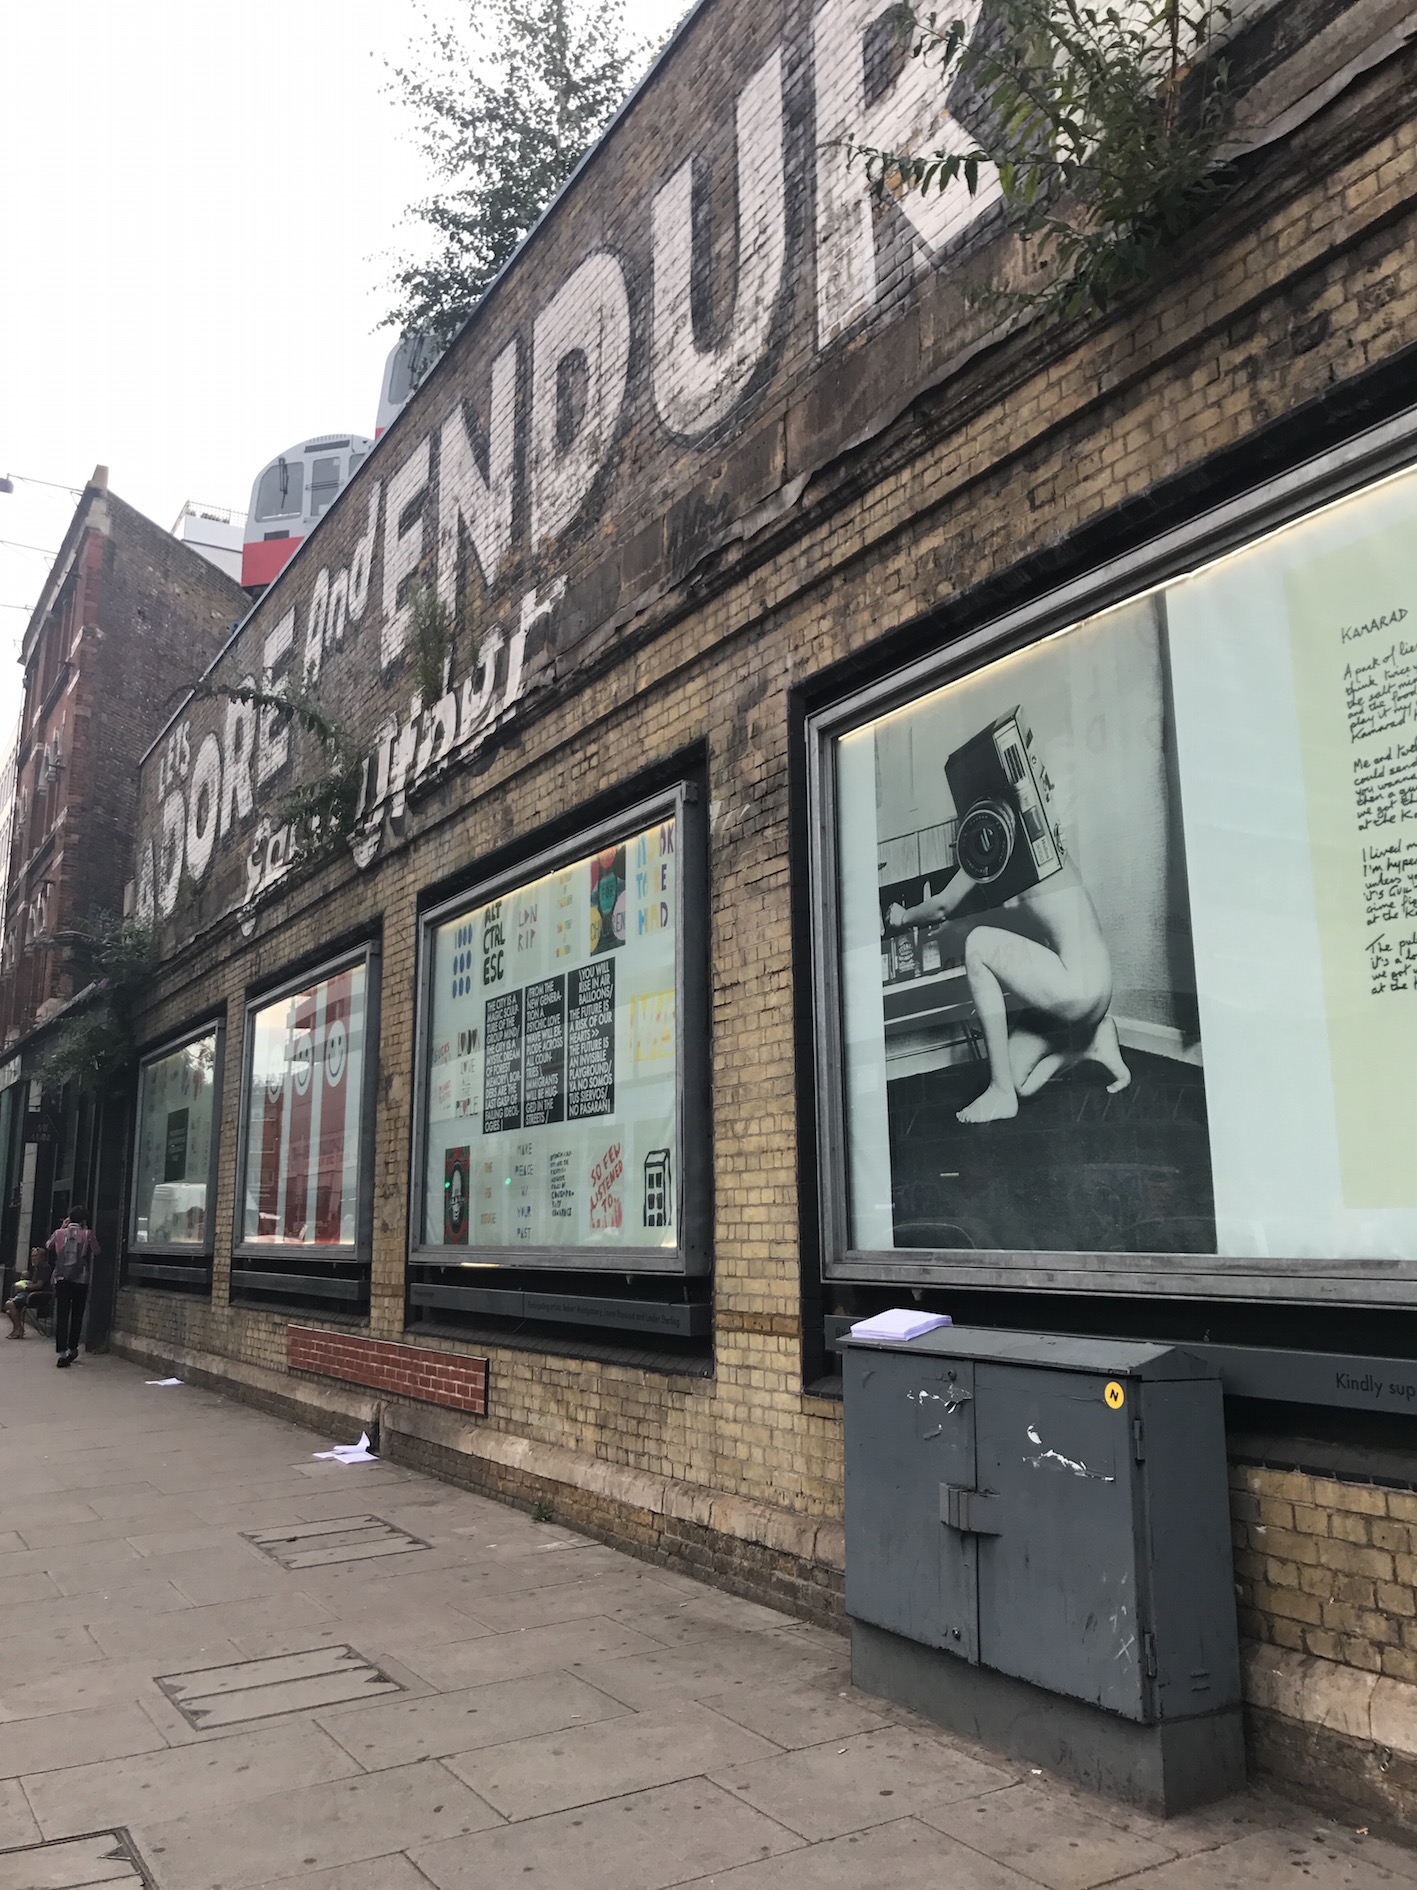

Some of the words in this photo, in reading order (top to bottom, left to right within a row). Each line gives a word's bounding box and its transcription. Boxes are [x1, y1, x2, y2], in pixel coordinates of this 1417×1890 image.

[1341, 608, 1408, 645] KAMARAD
[1343, 662, 1353, 681] A
[1382, 644, 1396, 667] of
[1351, 709, 1406, 745] Kamarad
[1353, 757, 1371, 774] Me
[1373, 746, 1393, 766] and
[1354, 764, 1385, 787] could
[483, 920, 506, 956] CTRL
[1364, 933, 1394, 955] The
[483, 949, 505, 986] ESC
[569, 1007, 581, 1021] THE
[598, 1010, 613, 1025] OUR
[569, 1043, 581, 1057] THE
[591, 1163, 603, 1188] SO
[602, 1141, 621, 1170] FEW
[516, 1227, 533, 1240] PAST
[1336, 1372, 1384, 1399] Kindly
[1389, 1383, 1416, 1402] sup
